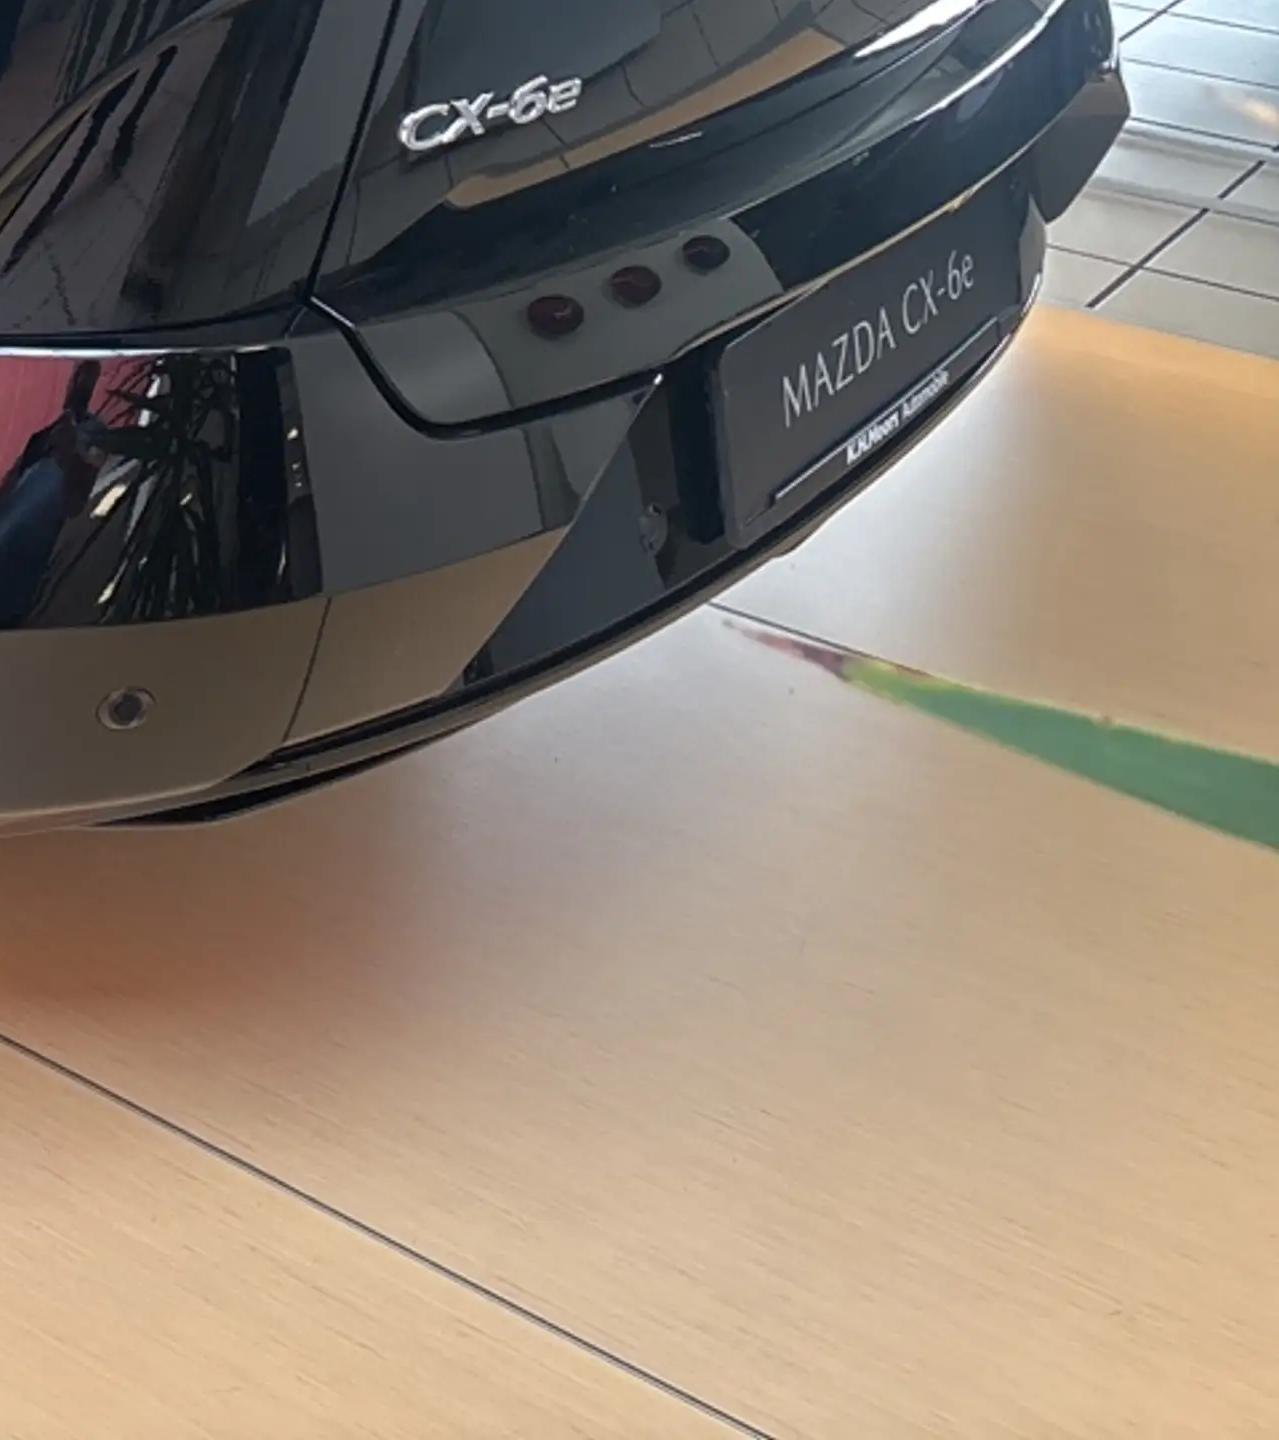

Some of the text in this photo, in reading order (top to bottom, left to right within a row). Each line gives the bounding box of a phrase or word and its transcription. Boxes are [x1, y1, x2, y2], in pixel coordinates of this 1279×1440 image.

[399, 75, 582, 151] CX-6e
[782, 250, 974, 428] MAZDA CX-6e
